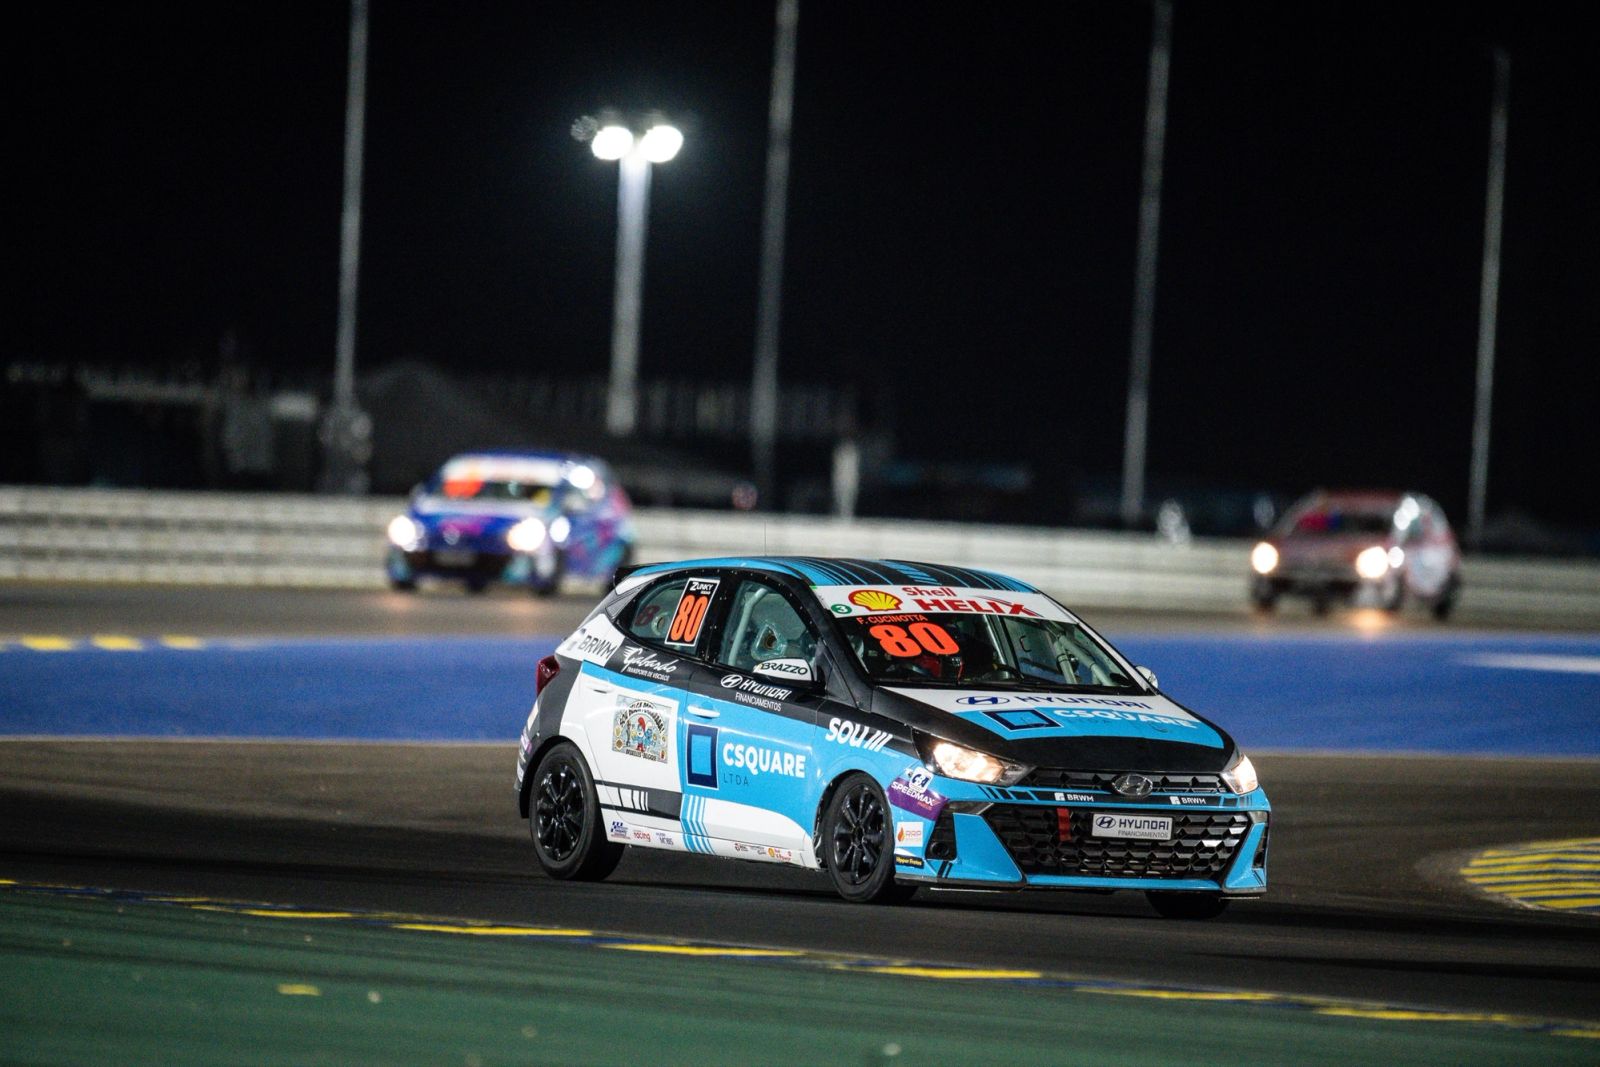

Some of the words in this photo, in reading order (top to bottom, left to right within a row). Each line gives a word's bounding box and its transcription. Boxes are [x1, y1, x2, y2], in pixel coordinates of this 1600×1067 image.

[902, 587, 957, 598] Shell
[913, 599, 1037, 617] HELIX
[670, 594, 709, 642] 80
[857, 617, 868, 625] F.
[869, 614, 928, 624] CUCINOTTA
[578, 635, 618, 660] BRWM
[869, 622, 960, 657] 80
[761, 662, 808, 676] BRAZZO
[739, 679, 792, 701] HYUNDAI
[735, 692, 782, 712] FINANCIAMENTOS
[1015, 695, 1153, 710] HYUNDAI
[1053, 709, 1198, 729] CSQUARE
[723, 743, 806, 779] CSQUARE
[723, 773, 749, 787] LTDA
[891, 781, 936, 807] SPEEDMAX
[1067, 794, 1094, 802] BRWM
[1118, 818, 1169, 831] HYUNDAI
[1117, 830, 1169, 839] FINANCIAMENTOS
